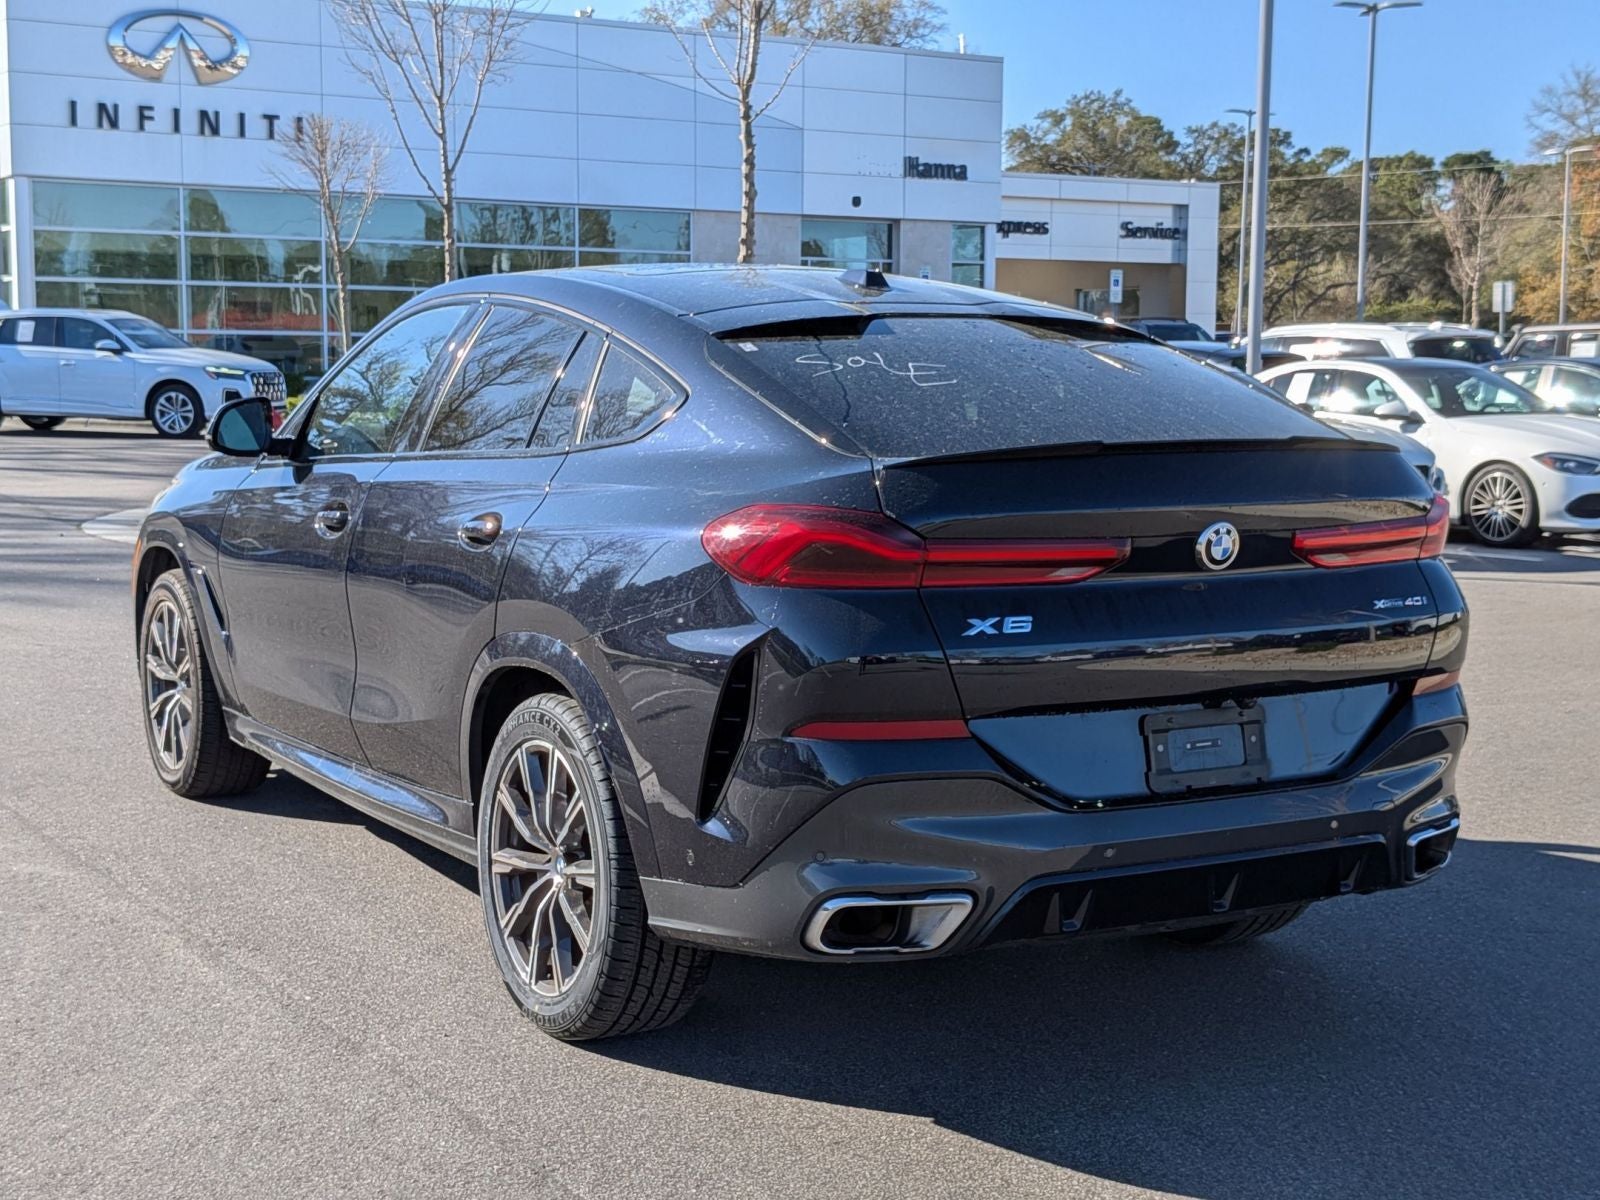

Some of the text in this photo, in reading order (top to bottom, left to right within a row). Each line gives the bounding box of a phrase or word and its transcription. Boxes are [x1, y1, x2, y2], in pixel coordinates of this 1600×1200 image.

[69, 99, 304, 143] INFINITI
[904, 156, 968, 181] Hanna
[1120, 221, 1181, 240] Service
[961, 616, 1033, 636] X6
